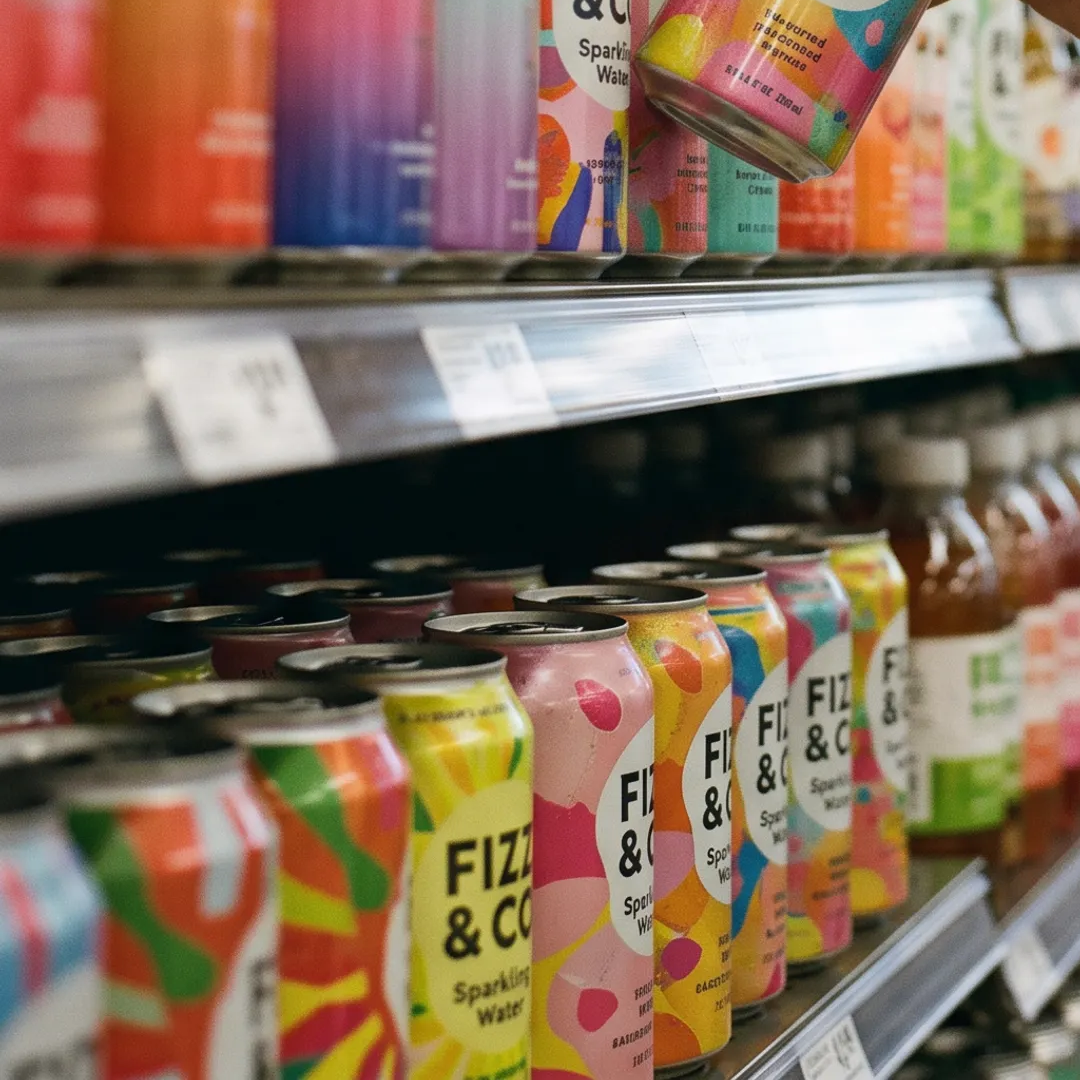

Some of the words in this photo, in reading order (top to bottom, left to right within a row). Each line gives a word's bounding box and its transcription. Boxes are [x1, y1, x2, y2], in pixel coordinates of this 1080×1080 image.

[804, 723, 829, 762] &
[756, 752, 777, 795] &
[702, 786, 723, 831] &
[618, 828, 643, 878] &
[443, 894, 482, 960] &
